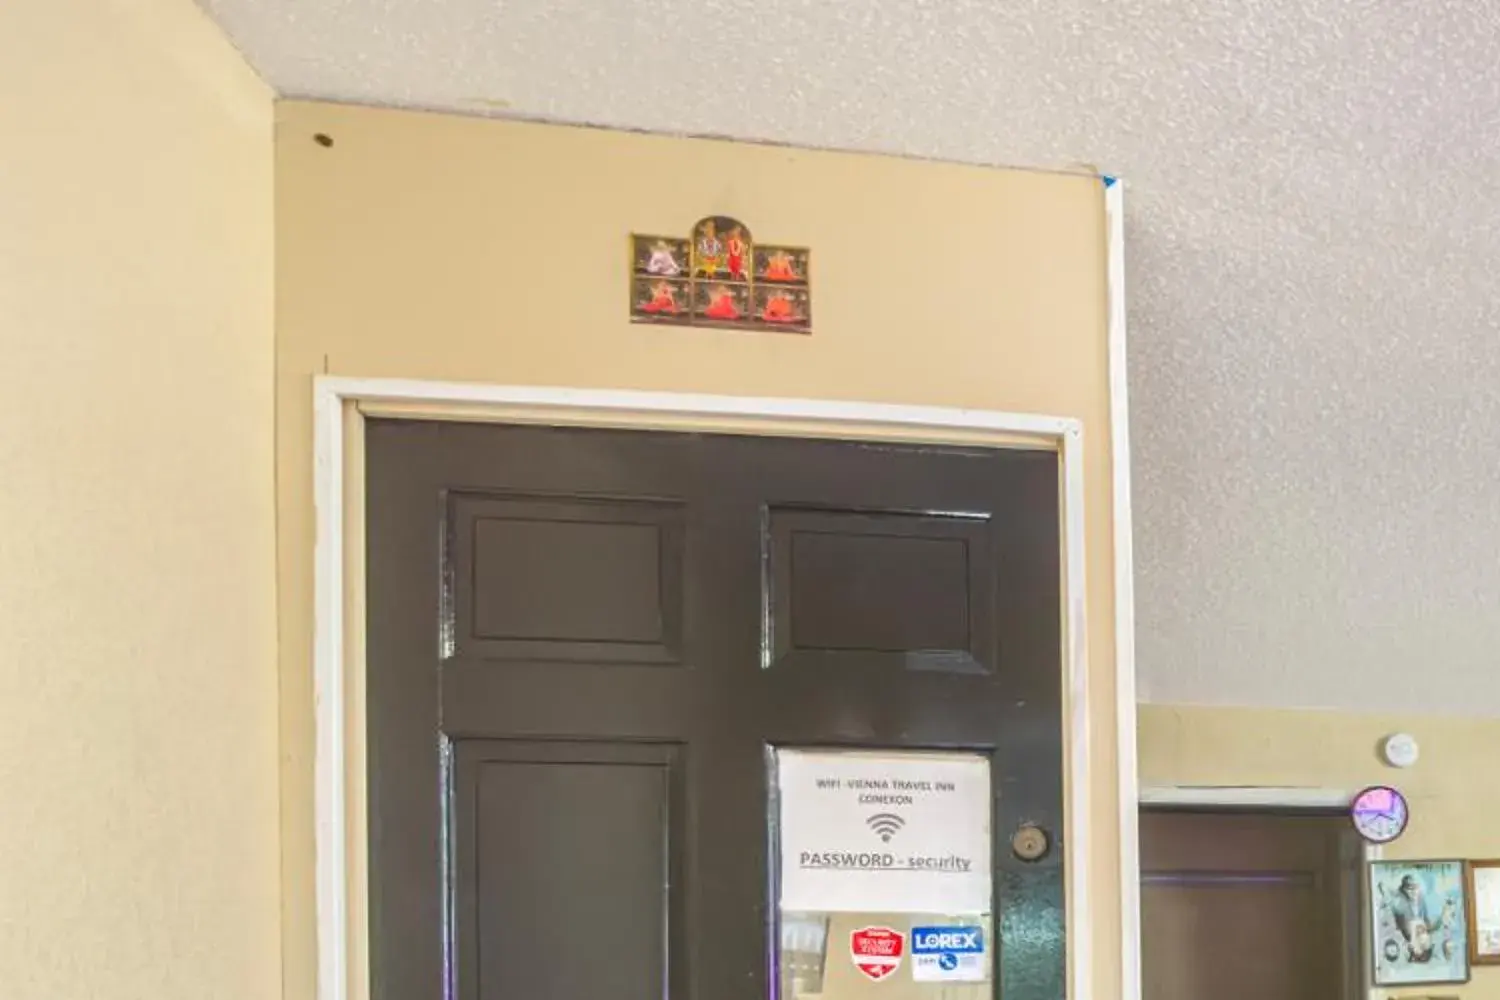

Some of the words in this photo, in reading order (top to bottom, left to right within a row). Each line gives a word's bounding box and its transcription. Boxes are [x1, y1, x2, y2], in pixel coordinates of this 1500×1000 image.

[892, 780, 931, 791] TRAVEL
[935, 782, 955, 791] INN
[800, 851, 894, 868] PASSWORD
[908, 856, 972, 870] security
[915, 932, 976, 949] LOREX
